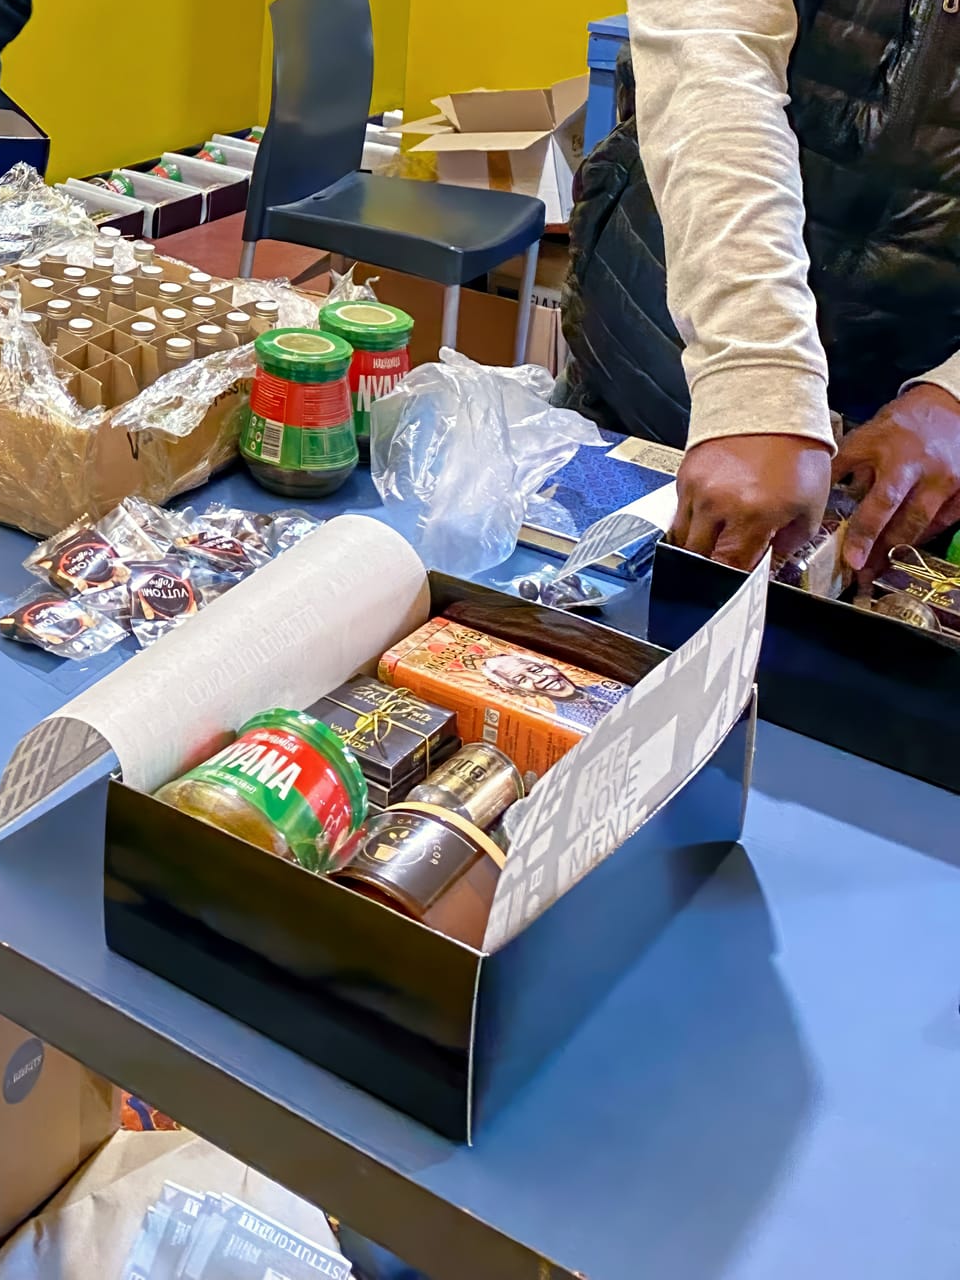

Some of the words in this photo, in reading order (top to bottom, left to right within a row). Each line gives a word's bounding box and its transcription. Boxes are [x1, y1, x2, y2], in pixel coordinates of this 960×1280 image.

[66, 550, 111, 575] VUTTOMI
[141, 587, 189, 599] VUTTOMI
[148, 577, 175, 589] Coffee
[330, 723, 375, 746] VANLLA
[575, 759, 642, 829] MOVE
